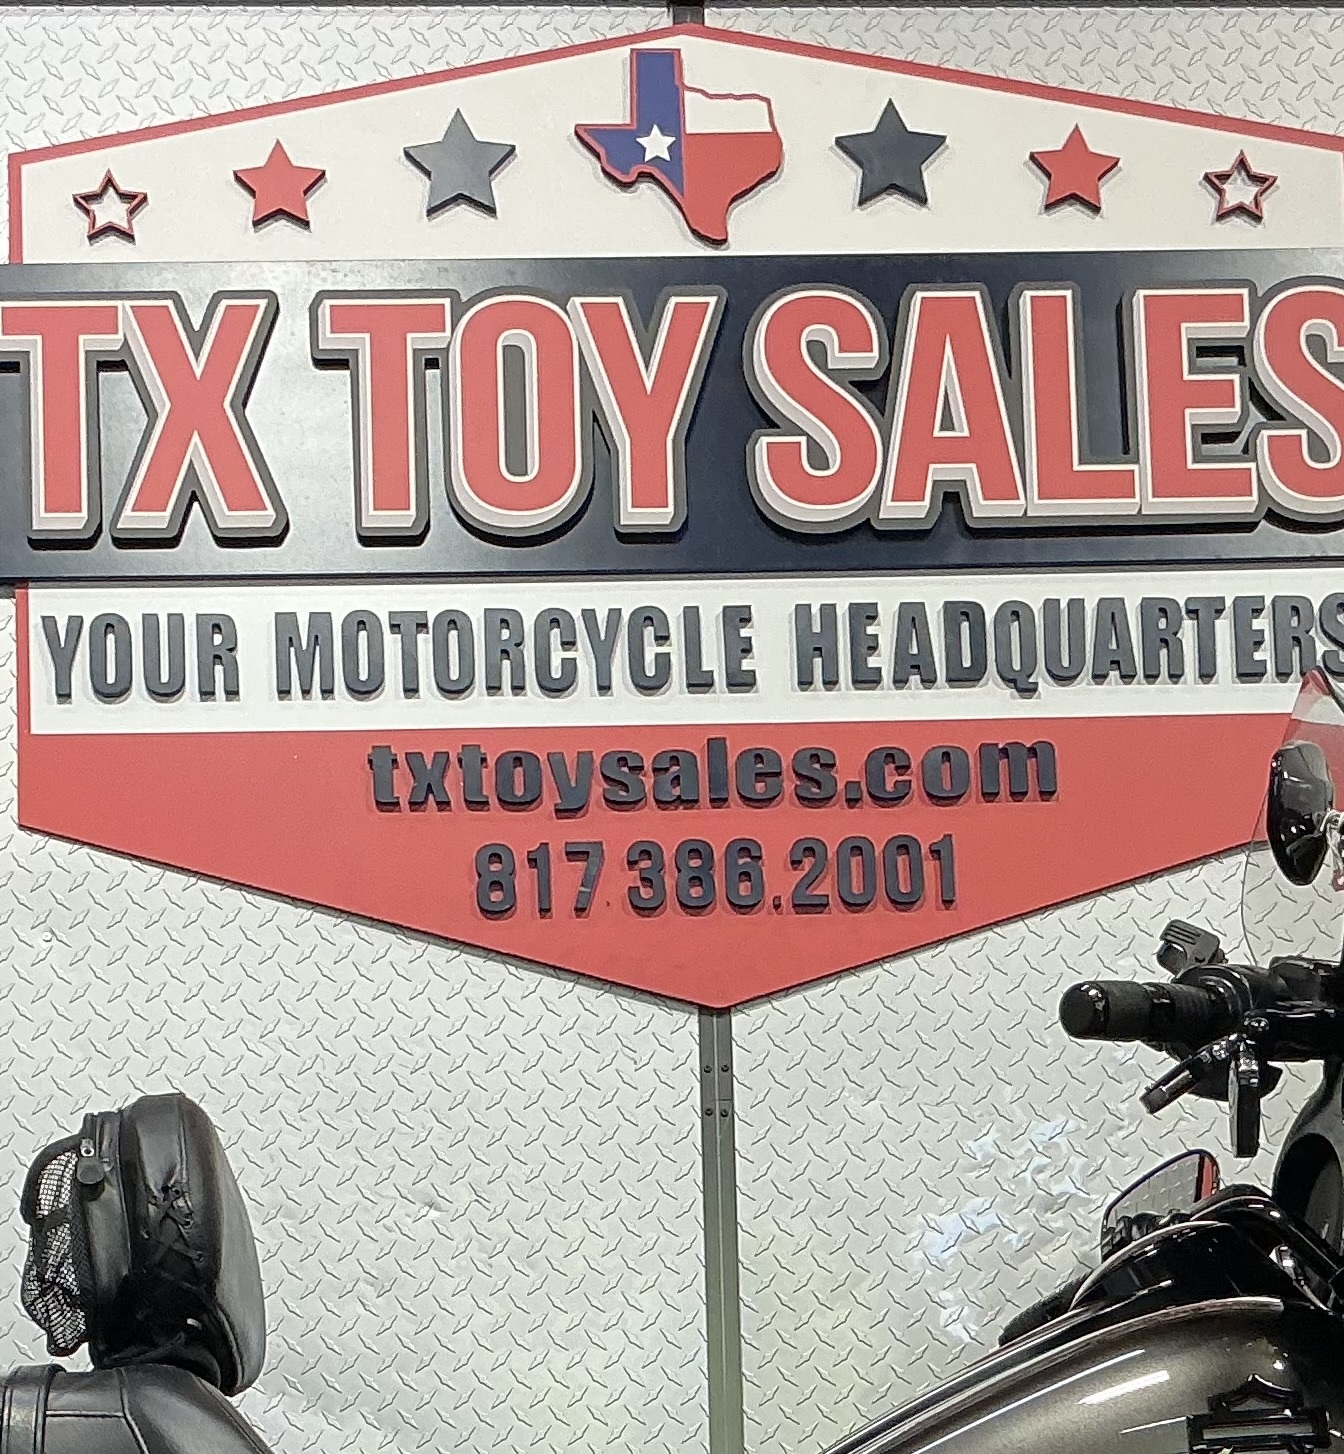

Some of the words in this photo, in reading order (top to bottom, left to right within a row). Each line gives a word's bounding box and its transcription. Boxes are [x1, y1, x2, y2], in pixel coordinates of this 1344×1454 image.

[313, 289, 722, 544] TOY
[42, 613, 241, 703] YOUR
[275, 604, 758, 700] MOTORCYCLE
[368, 737, 1058, 818] txtoysales.com
